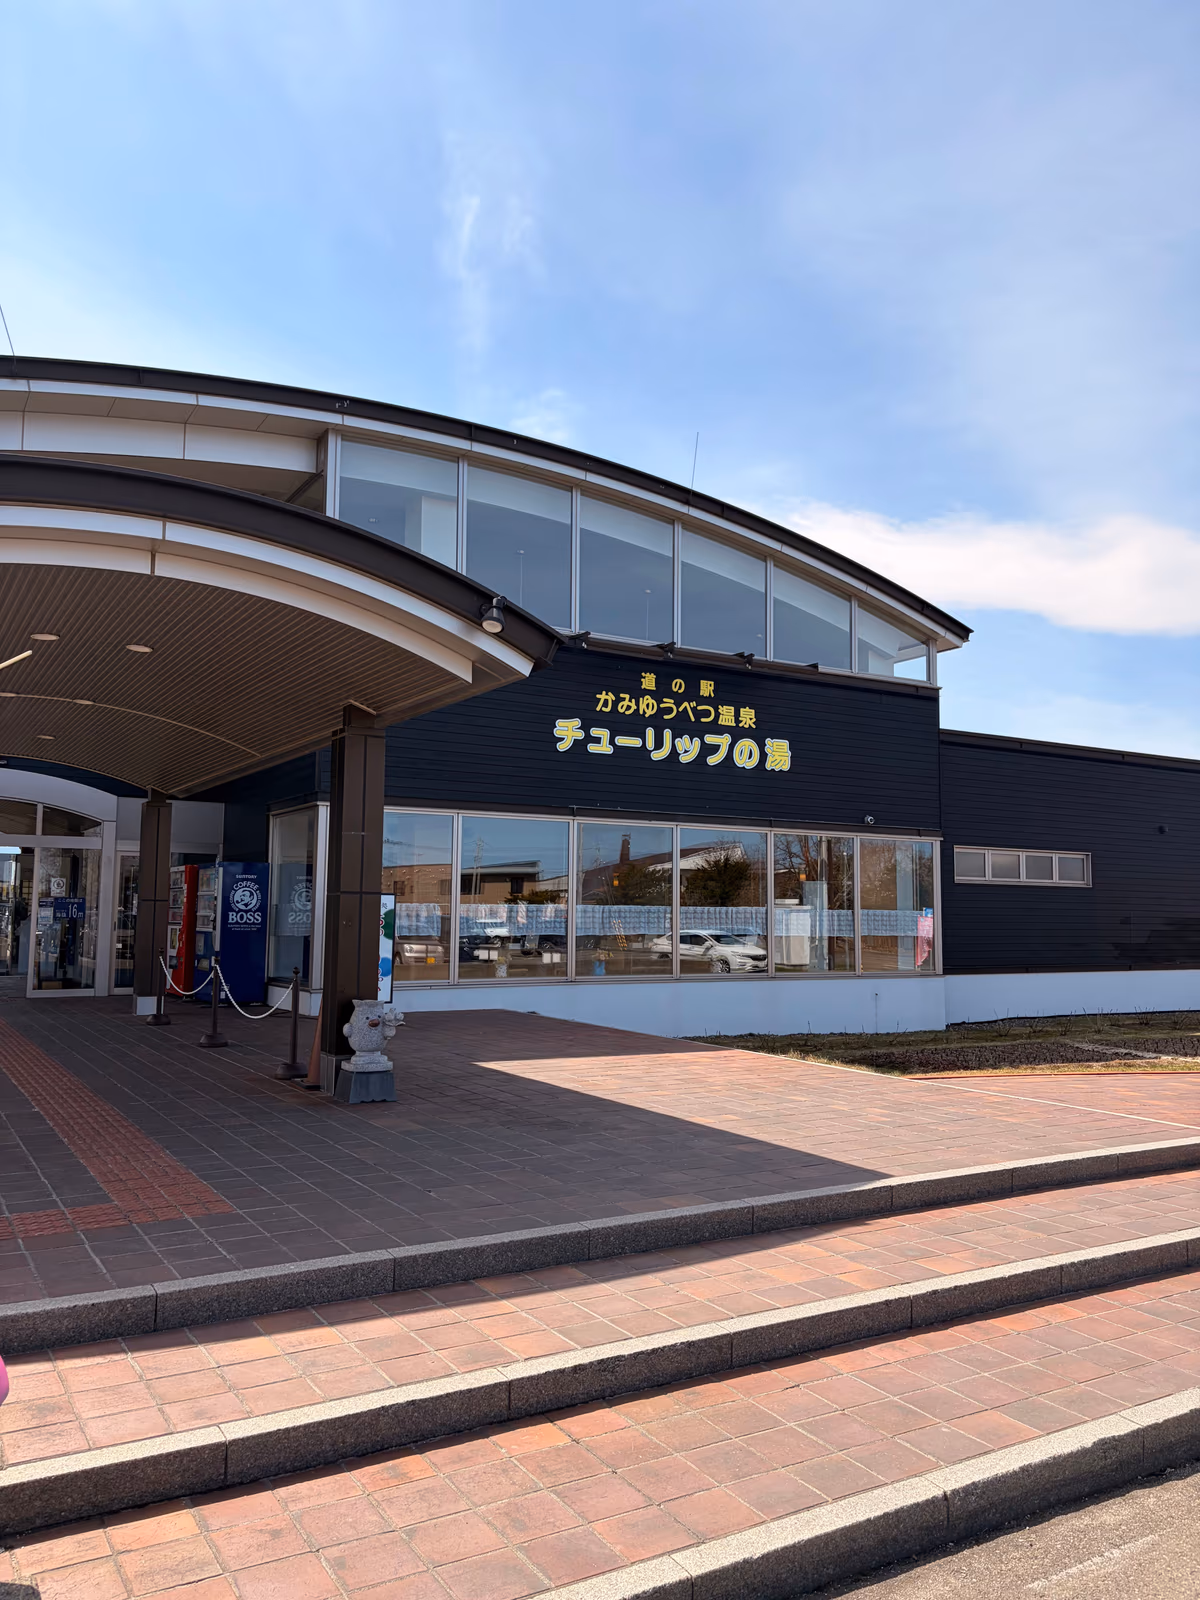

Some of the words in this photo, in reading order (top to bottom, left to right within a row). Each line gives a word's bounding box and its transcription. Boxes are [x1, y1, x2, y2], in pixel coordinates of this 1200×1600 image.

[641, 672, 715, 698] 道の駅
[595, 690, 757, 729] かみゆうべつ温泉
[553, 718, 791, 772] チューリップの湯
[233, 881, 259, 890] COFFEE
[228, 911, 261, 923] BOSS
